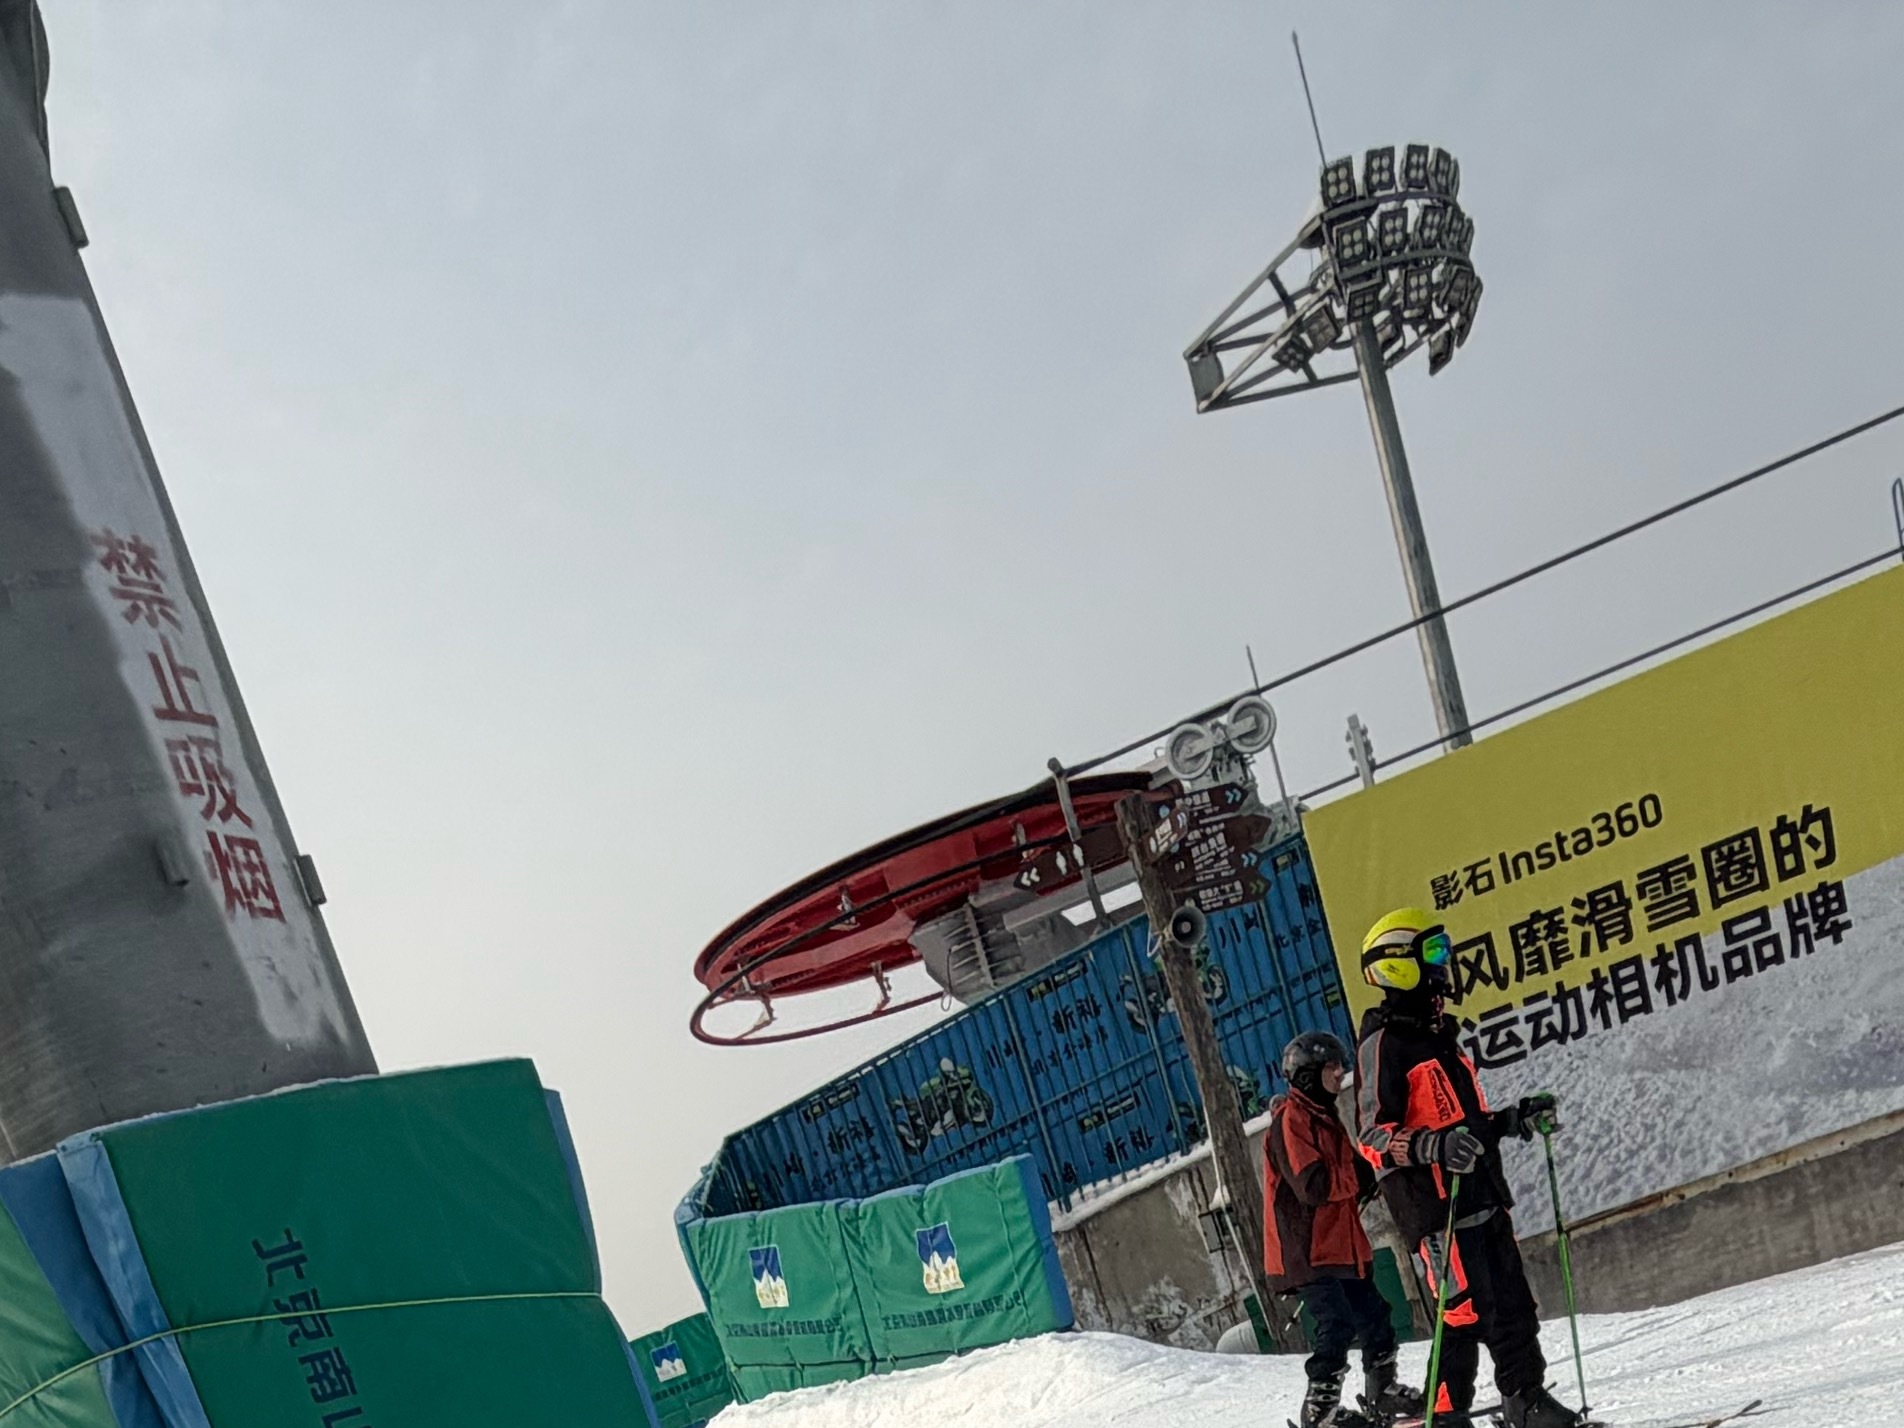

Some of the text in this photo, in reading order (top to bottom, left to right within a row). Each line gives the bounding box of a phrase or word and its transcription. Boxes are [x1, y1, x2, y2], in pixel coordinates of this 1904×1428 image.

[89, 528, 287, 924] 禁止吸烟
[1430, 792, 1664, 912] 影石 Insta360
[1446, 803, 1839, 1006] 风靡滑雪圈的
[1463, 881, 1854, 1071] 运动相机品牌
